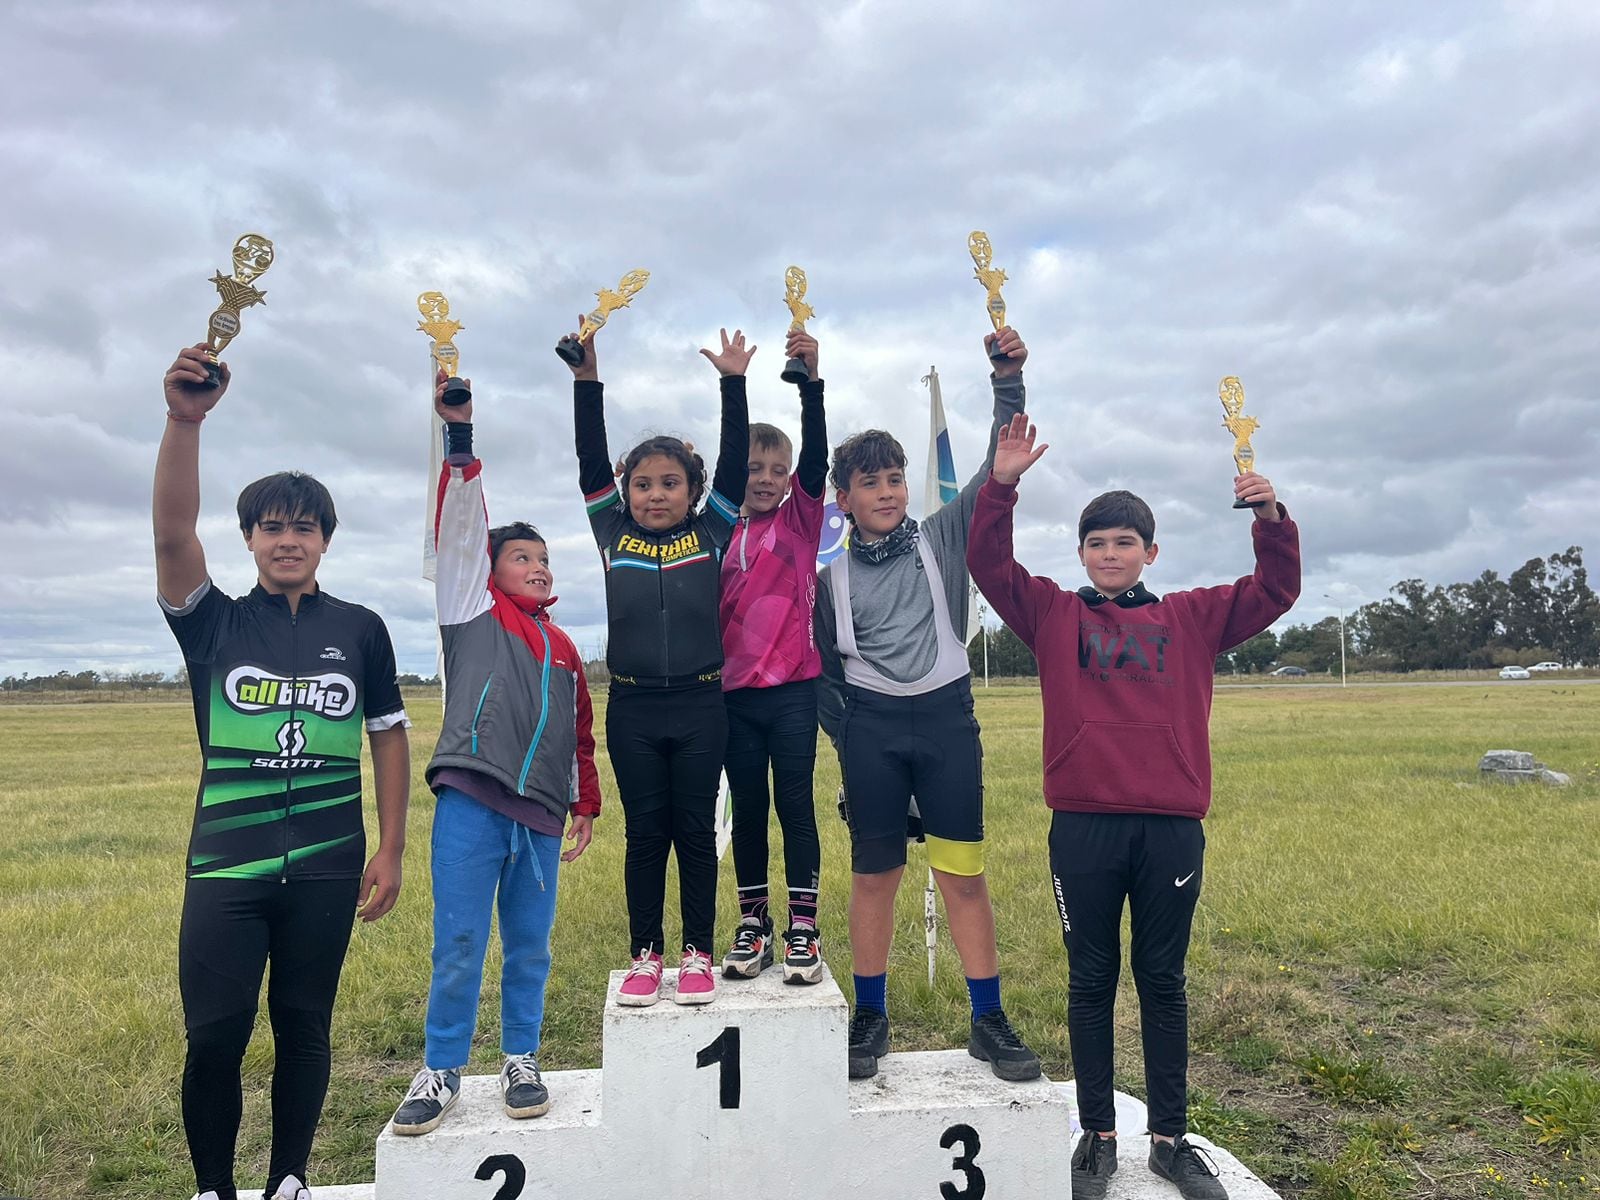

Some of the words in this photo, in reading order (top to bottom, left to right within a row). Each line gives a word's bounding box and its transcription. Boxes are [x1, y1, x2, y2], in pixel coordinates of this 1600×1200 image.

[617, 530, 699, 557] FERRARI
[1078, 633, 1171, 671] WAT
[239, 680, 344, 712] allbike
[252, 758, 326, 769] SCOTT
[1053, 874, 1064, 903] JUST
[1060, 904, 1068, 919] DO
[694, 1026, 741, 1109] 1
[939, 1124, 985, 1200] 3
